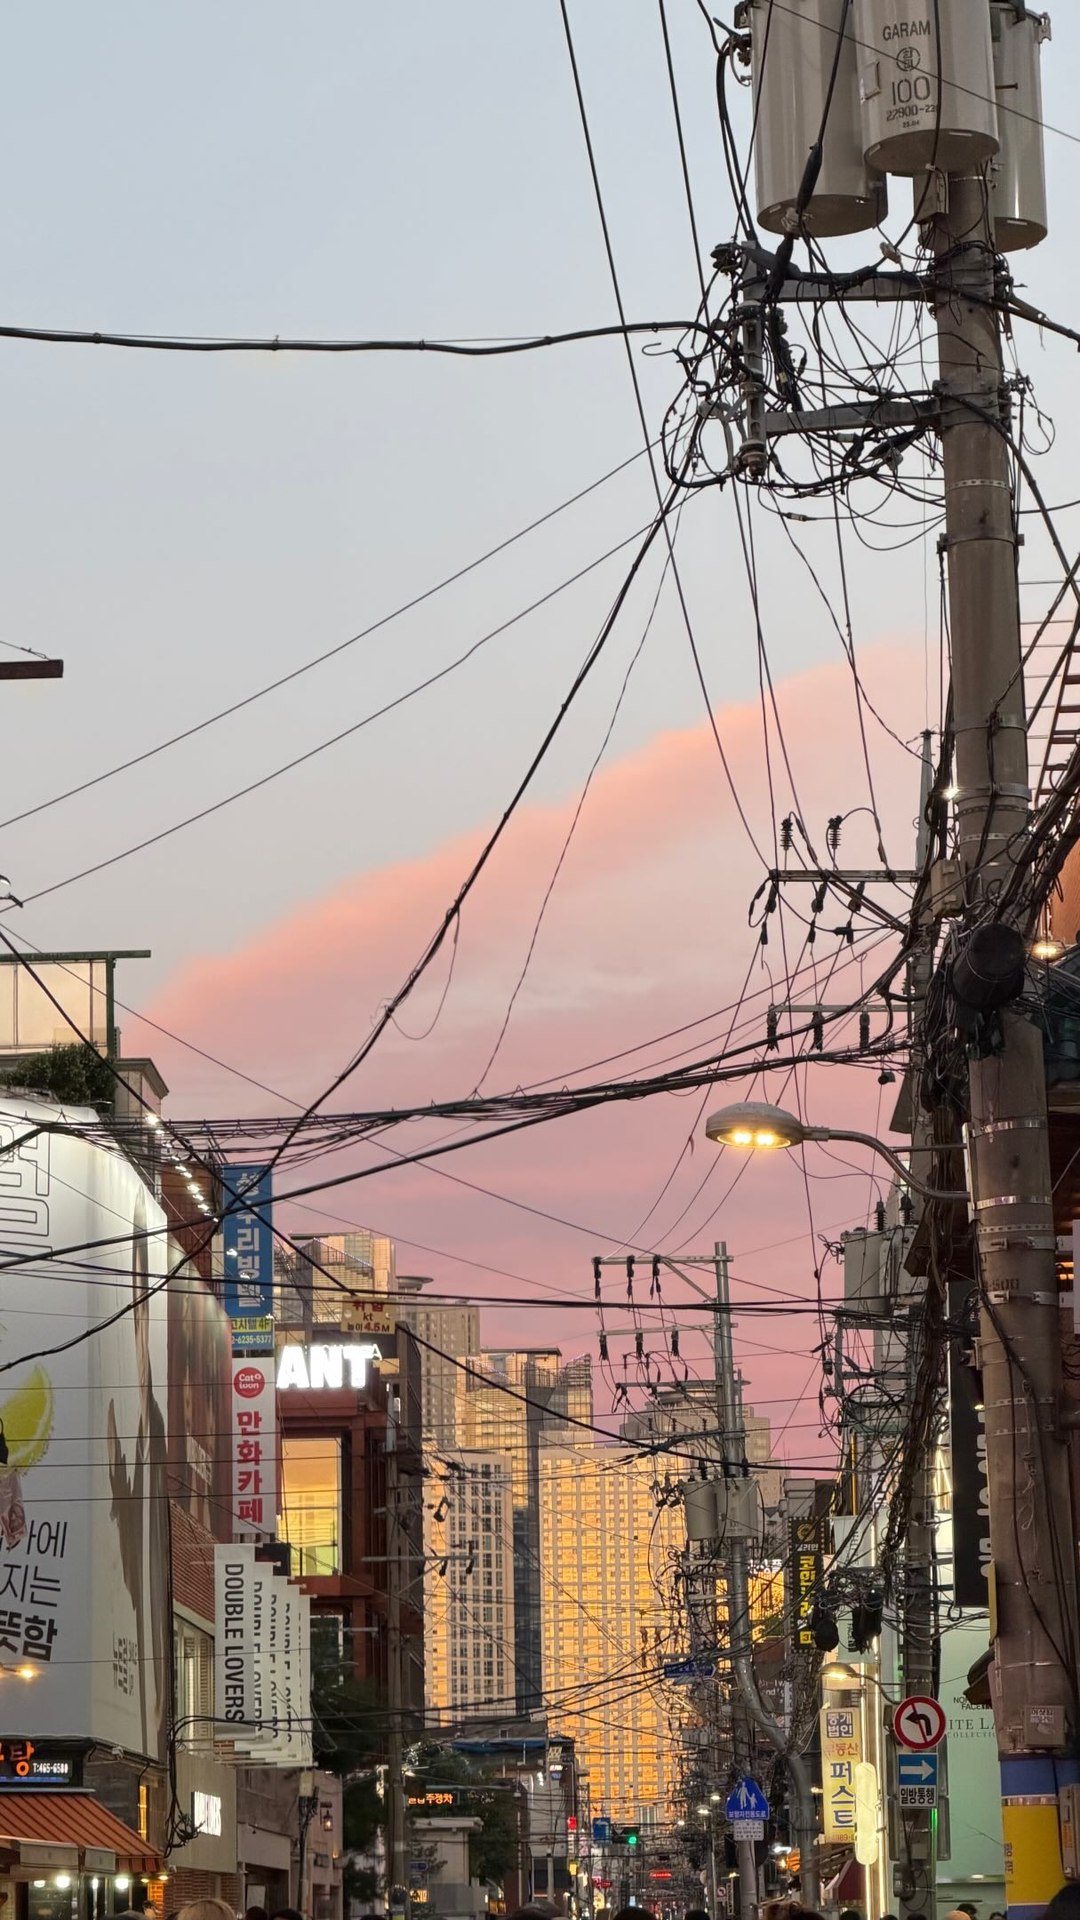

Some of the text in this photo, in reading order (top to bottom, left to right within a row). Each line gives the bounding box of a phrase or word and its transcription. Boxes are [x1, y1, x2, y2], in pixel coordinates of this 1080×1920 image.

[883, 20, 931, 41] GARAM
[892, 76, 930, 106] 100
[363, 1313, 374, 1322] kt
[237, 1410, 262, 1523] 만화카페
[225, 1563, 245, 1722] DOUBLE LOVERS
[830, 1761, 855, 1828] 퍼스트
[900, 1787, 935, 1805] 일방통행
